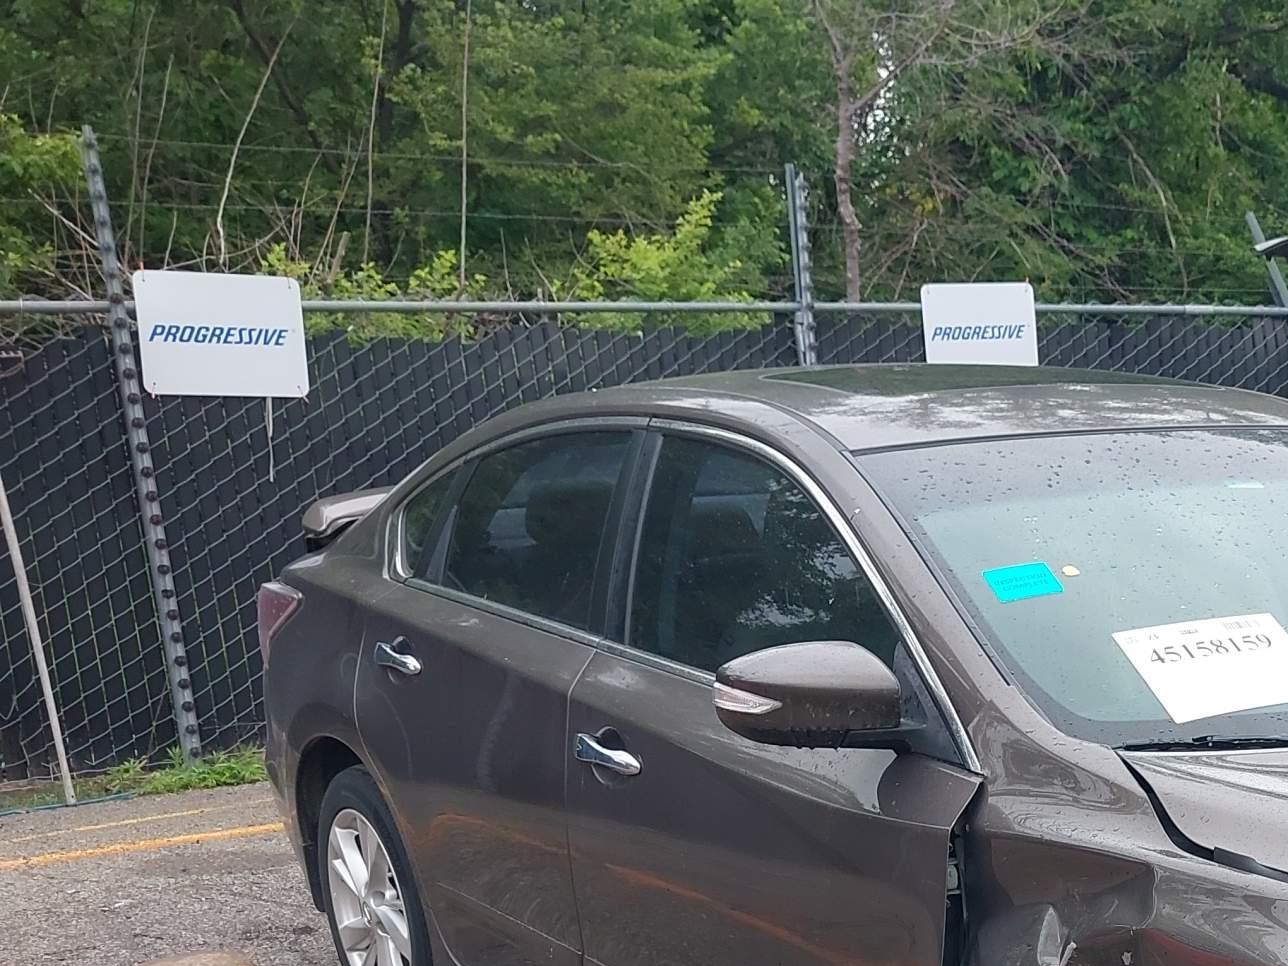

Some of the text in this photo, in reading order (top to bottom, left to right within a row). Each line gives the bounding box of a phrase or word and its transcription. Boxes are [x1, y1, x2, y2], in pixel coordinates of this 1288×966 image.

[149, 324, 289, 346] PROGRESSIVE
[931, 324, 1025, 341] PROGRESSIVE
[1150, 634, 1272, 664] 45158159
